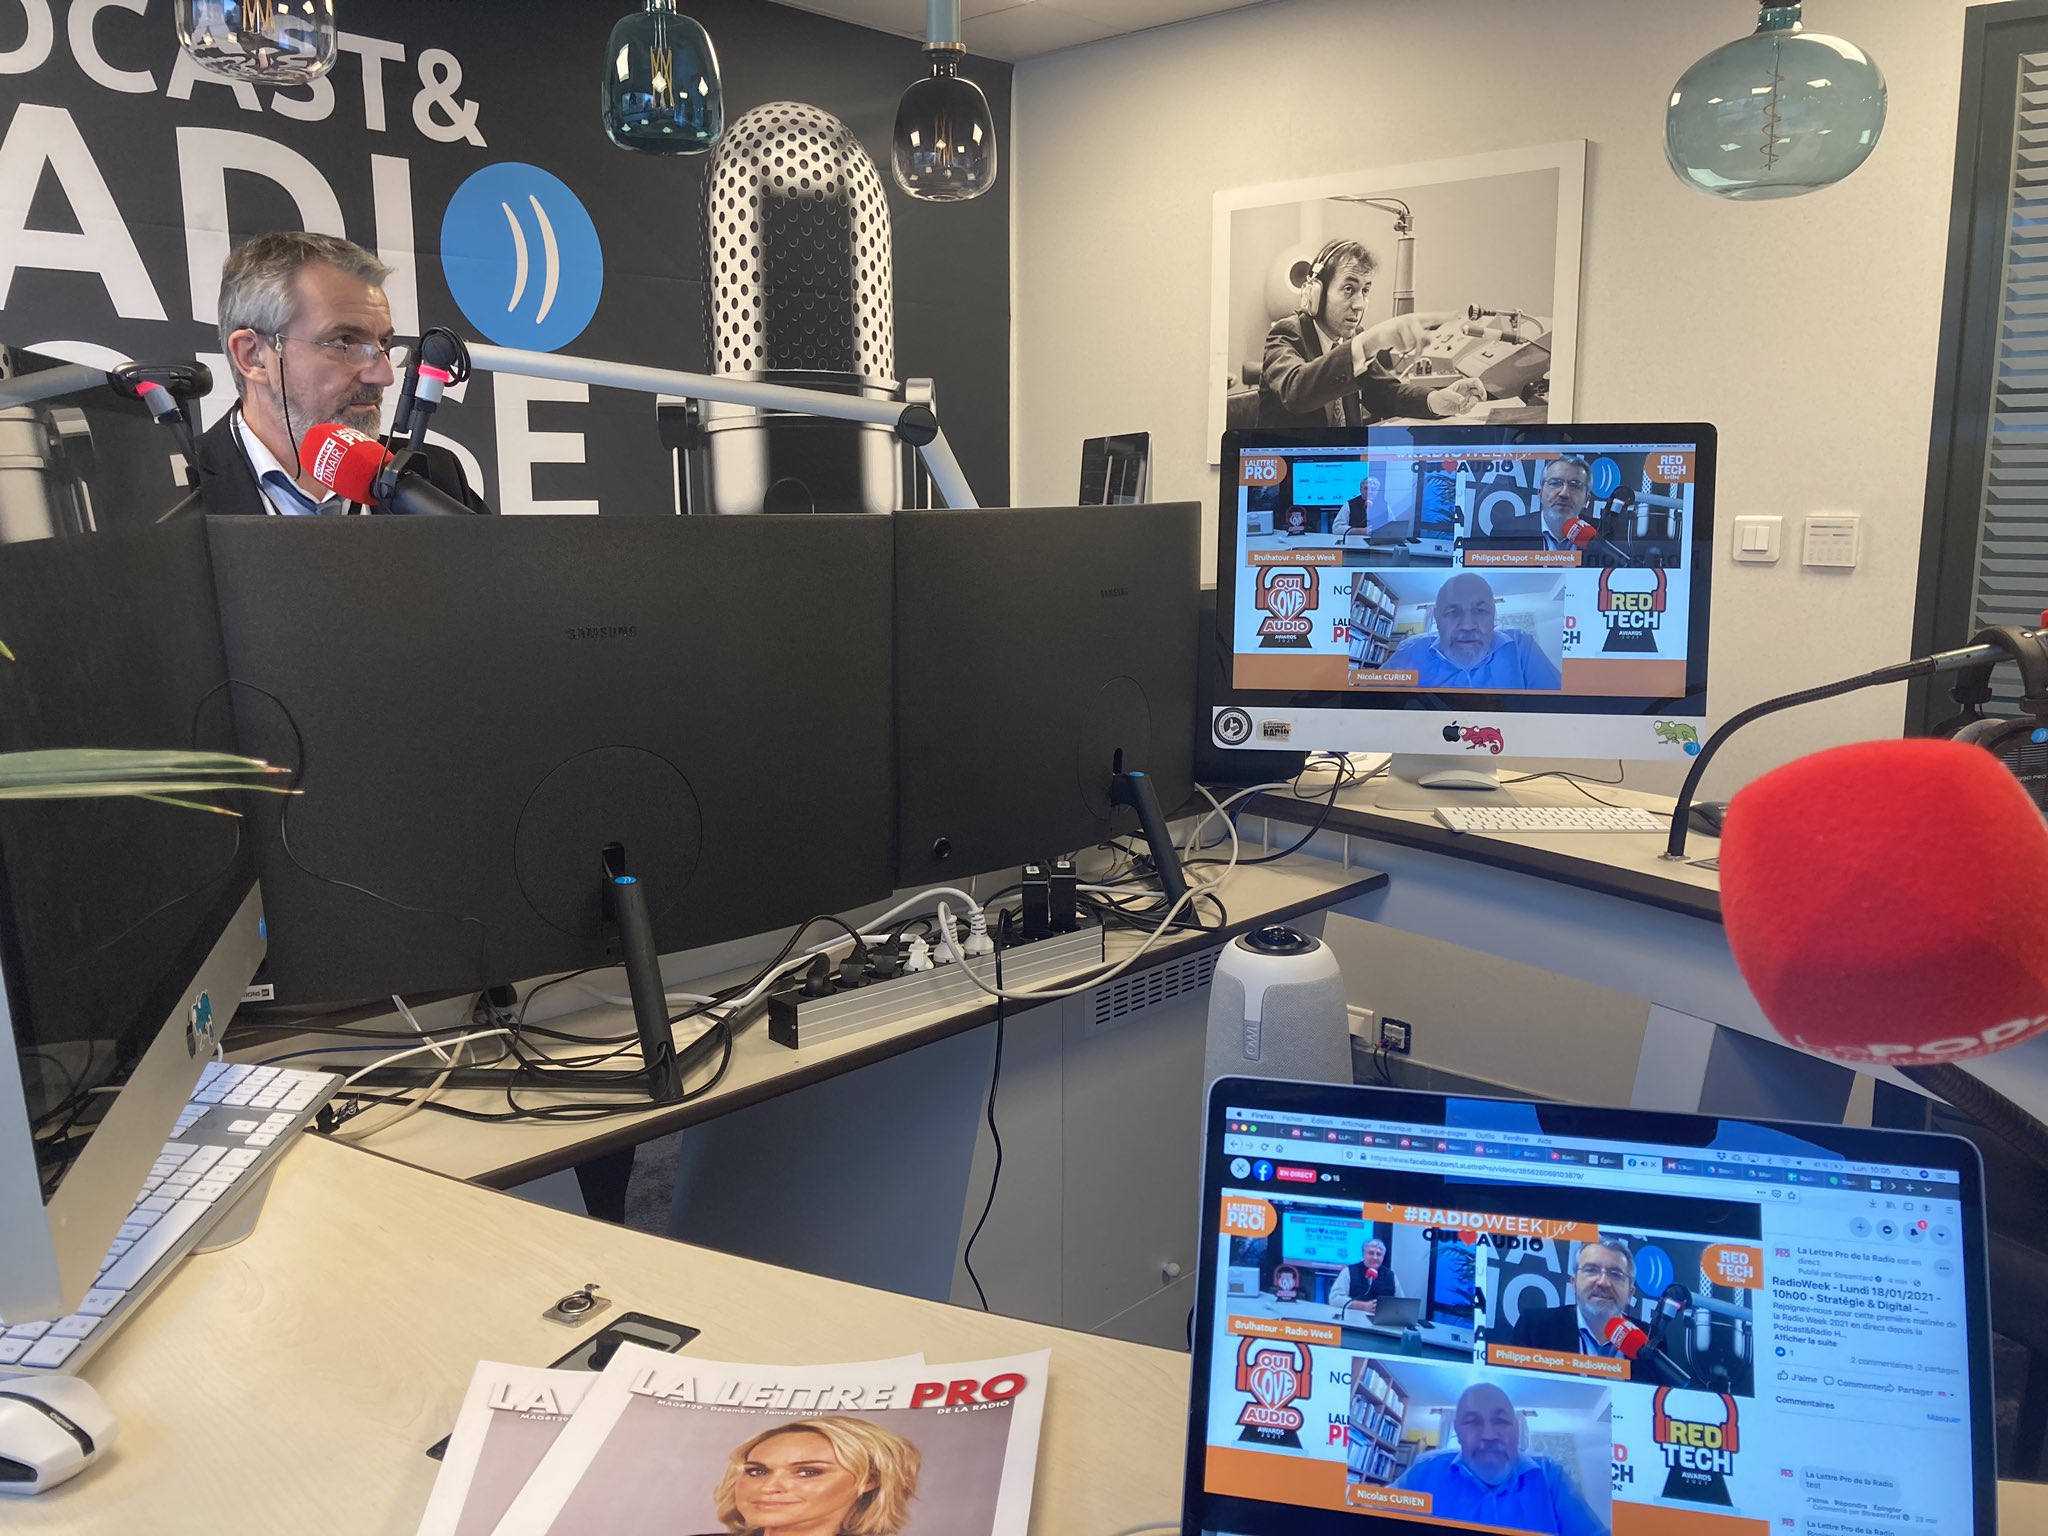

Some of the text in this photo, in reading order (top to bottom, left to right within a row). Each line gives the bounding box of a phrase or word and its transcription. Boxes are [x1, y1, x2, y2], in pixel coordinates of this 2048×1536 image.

[315, 440, 333, 478] CONNECT
[322, 448, 344, 483] ONAIR
[1411, 461, 1514, 473] OUI AUDIO
[1660, 455, 1683, 465] RED
[1245, 467, 1274, 479] PRO
[1657, 465, 1687, 475] TECH
[1254, 554, 1337, 562] Brulhatour Radio Week
[1471, 554, 1501, 563] Philippe
[1502, 554, 1529, 563] Chapot
[1535, 554, 1575, 562] RadioWeek
[1275, 579, 1299, 589] OUI
[1270, 591, 1303, 616] LOVE
[1611, 594, 1653, 611] RED
[1265, 621, 1308, 632] AUDIO
[1604, 612, 1658, 628] TECH
[567, 625, 637, 640] SAMSUNG
[1357, 673, 1412, 681] Nicolas CURIEN
[1251, 1112, 1274, 1120] Firefox
[1290, 1171, 1314, 1179] DIRECT
[1332, 1174, 1341, 1182] 15
[1227, 1211, 1263, 1230] PRO
[1404, 1207, 1577, 1239] #RADIOWEEK Live
[1477, 1233, 1543, 1252] AUDIO
[1720, 1251, 1749, 1265] RED
[1797, 1247, 1807, 1255] La
[1809, 1249, 1833, 1258] Lettre
[1835, 1251, 1849, 1259] Pro
[1851, 1252, 1861, 1260] de
[1872, 1255, 1896, 1264] Radio
[1717, 1263, 1753, 1278] TECH
[1772, 1277, 1934, 1303] RadioWeek Lundi 18/01/2021
[1773, 1290, 1912, 1314] 10h00 Stratégie & Digital
[1773, 1302, 1833, 1315] Rejoignez-nous
[1834, 1309, 1852, 1318] pour
[1854, 1311, 1875, 1320] cette
[1876, 1313, 1912, 1324] première
[1913, 1316, 1945, 1327] matinée
[1235, 1320, 1334, 1340] Brulhatour Radio Week
[1773, 1324, 1833, 1337] Podcast&Radio
[1782, 1314, 1804, 1323] Radio
[1806, 1316, 1828, 1326] Week
[1829, 1319, 1849, 1328] 2021
[1862, 1323, 1885, 1332] direct
[1887, 1325, 1913, 1335] depuis
[1915, 1328, 1923, 1336] la
[1774, 1334, 1838, 1347] Afficher la suite
[1261, 1355, 1289, 1369] OUI
[1495, 1350, 1531, 1364] Philippe
[1532, 1354, 1565, 1367] Chapot
[1572, 1359, 1622, 1373] RadioWeek
[1858, 1358, 1914, 1370] commentaires
[1924, 1366, 1960, 1376] partages
[629, 1368, 1027, 1411] LA LETTRE PRO
[1255, 1369, 1293, 1408] LOVE
[1791, 1374, 1934, 1397] J'aime Commenter Partager
[488, 1382, 561, 1415] LA
[1775, 1395, 1835, 1410] Commentaires
[657, 1400, 703, 1410] MAG#129
[710, 1406, 756, 1415] Décembre
[763, 1409, 799, 1417] Janvier
[937, 1400, 1010, 1415] DE LA RADIO
[1246, 1408, 1299, 1425] AUDIO
[1257, 1427, 1285, 1436] AWARDS
[1670, 1421, 1722, 1448] RED
[1662, 1443, 1731, 1474] TECH
[1681, 1472, 1712, 1482] AWARDS
[1805, 1471, 1894, 1488] La Lettre Pro de la Radio
[1806, 1481, 1821, 1489] test
[1357, 1489, 1425, 1507] Nicolas CURIEN
[1817, 1522, 1840, 1531] Lettre
[1840, 1524, 1853, 1533] Pro
[1855, 1526, 1864, 1534] de
